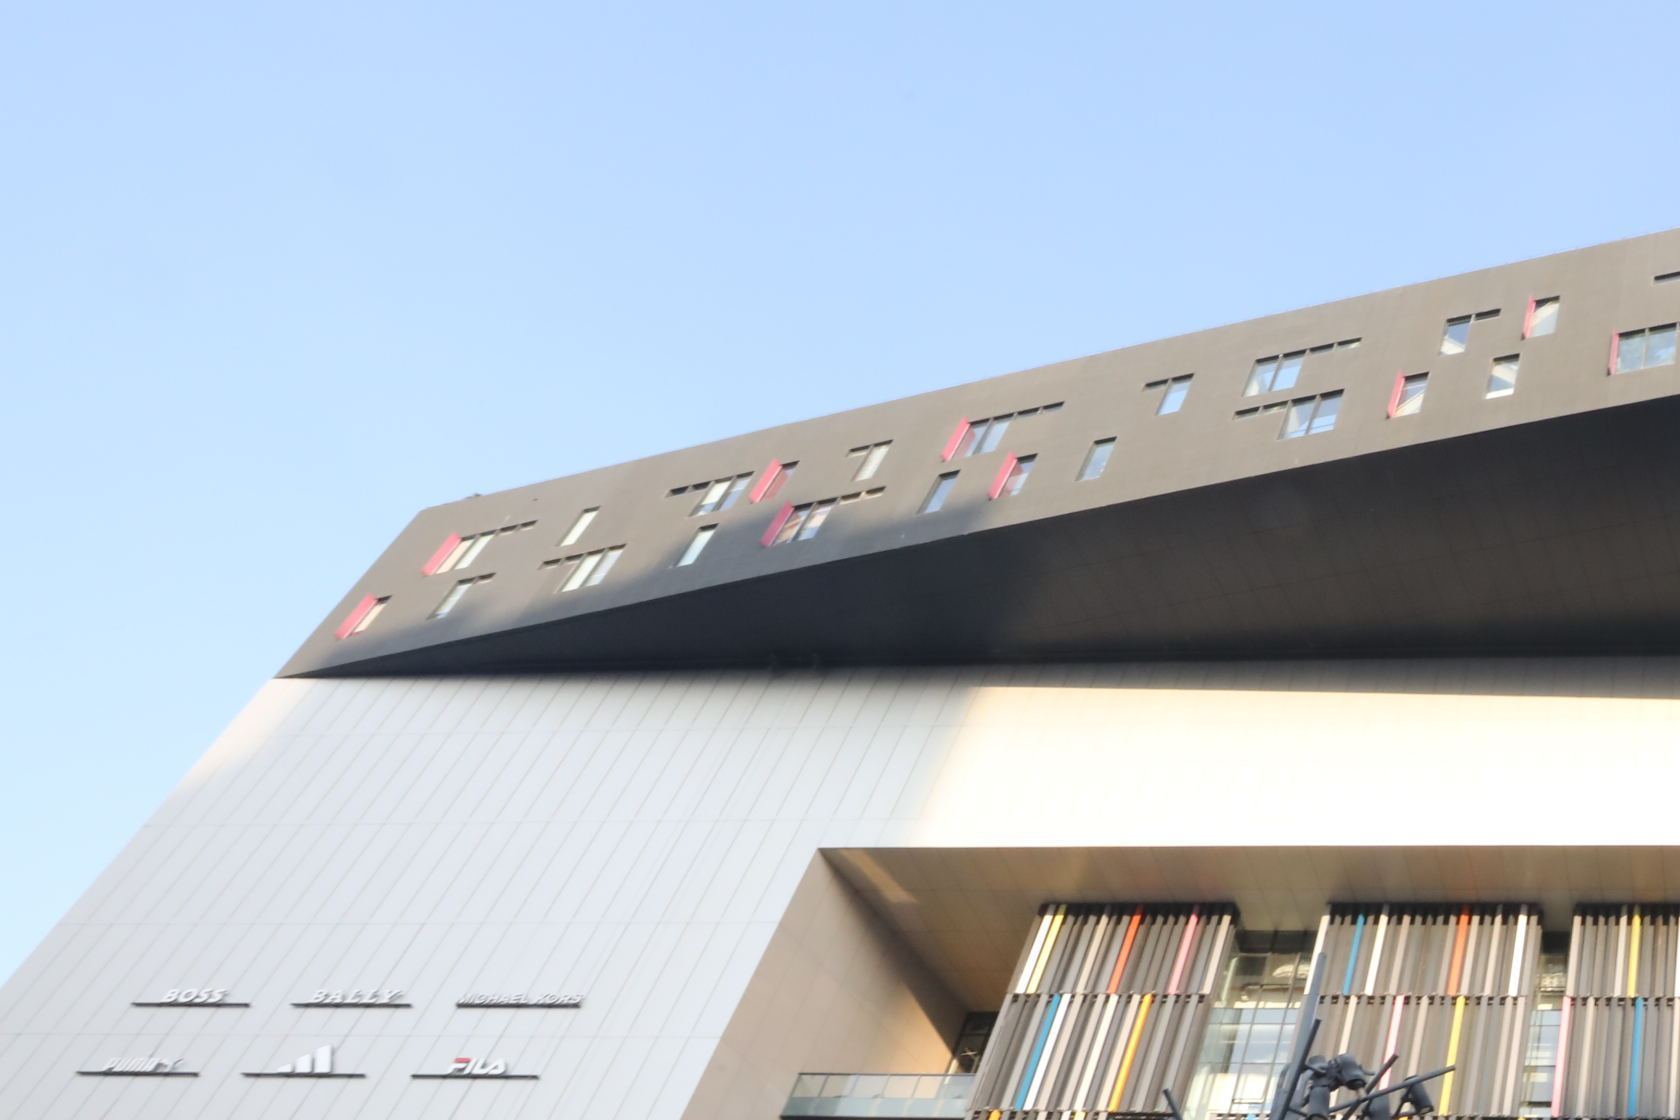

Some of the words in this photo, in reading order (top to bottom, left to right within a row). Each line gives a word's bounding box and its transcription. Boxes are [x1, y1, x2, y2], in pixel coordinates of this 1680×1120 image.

[161, 988, 228, 1003] BOSS
[312, 989, 403, 1004] BALLY
[457, 992, 530, 1005] MICHAEL
[537, 992, 584, 1005] KORS
[446, 1057, 506, 1075] FILA
